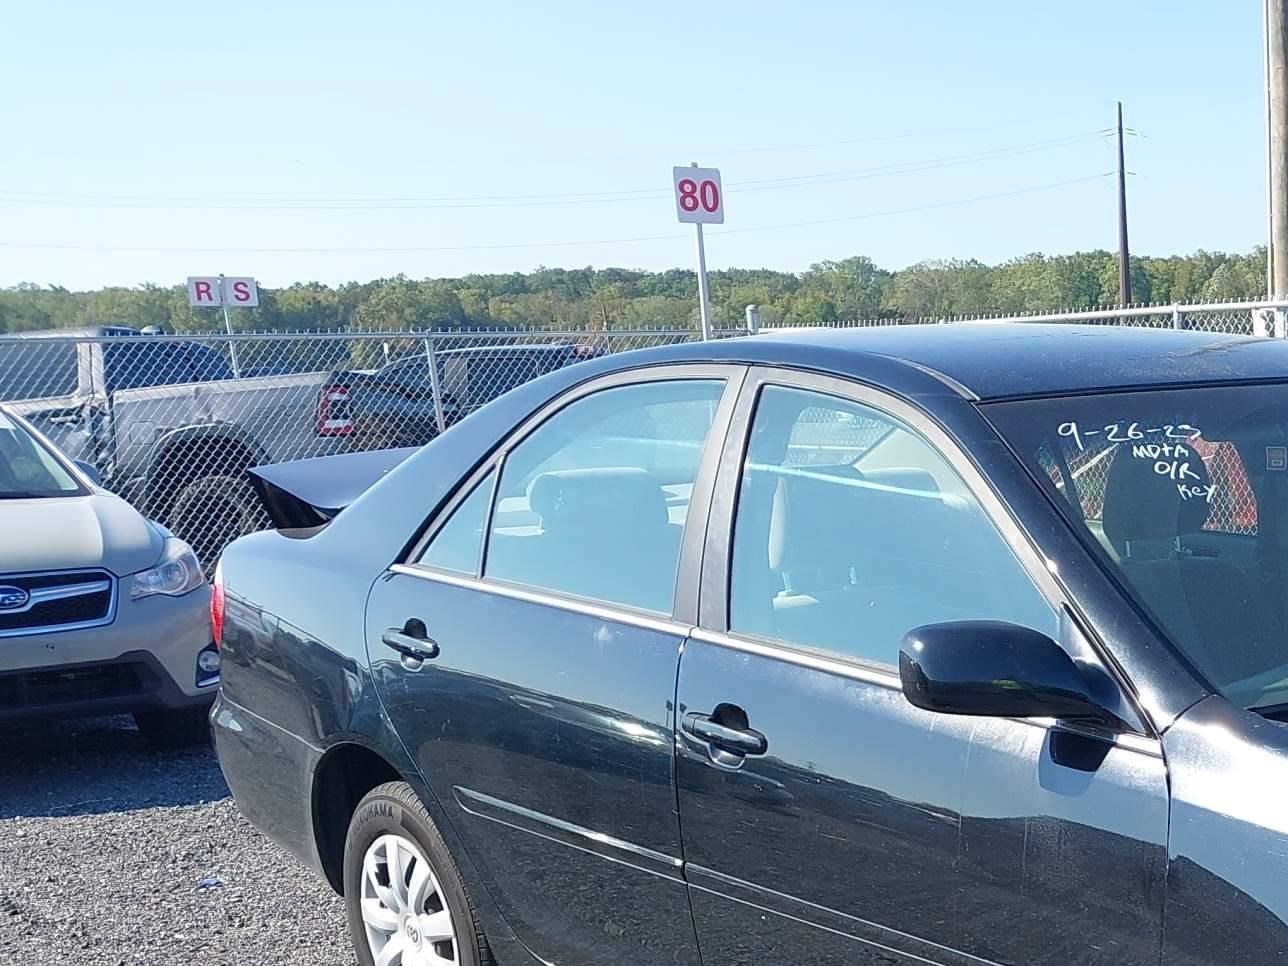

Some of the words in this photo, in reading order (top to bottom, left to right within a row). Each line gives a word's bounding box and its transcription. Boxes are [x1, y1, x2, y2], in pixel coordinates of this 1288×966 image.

[678, 178, 720, 213] 80
[194, 281, 214, 302] R
[233, 281, 251, 302] S
